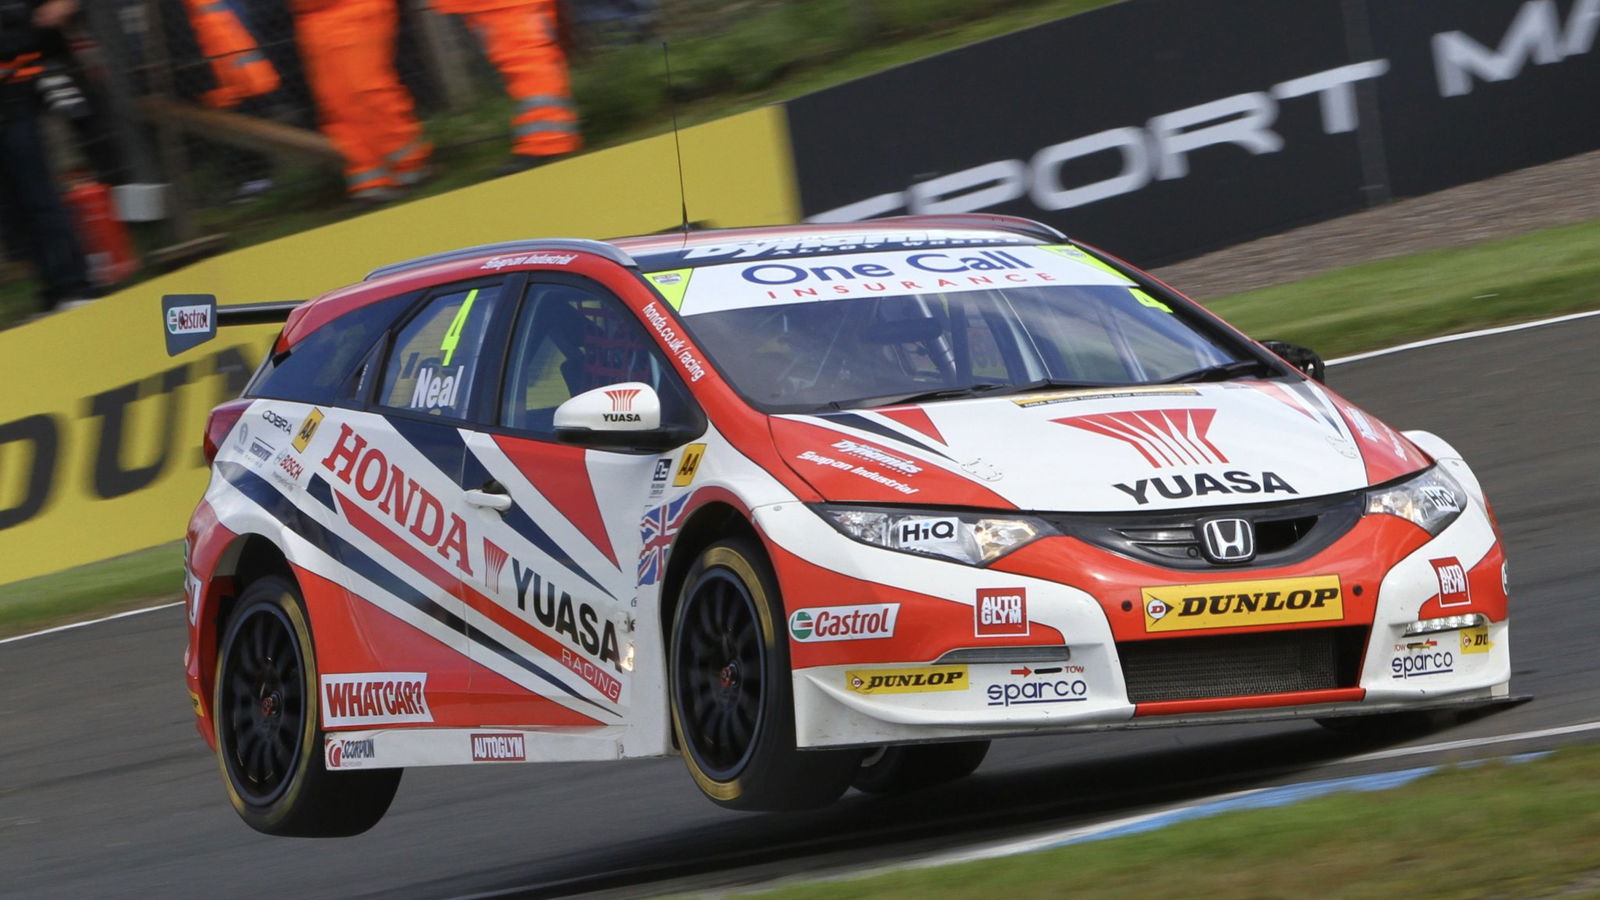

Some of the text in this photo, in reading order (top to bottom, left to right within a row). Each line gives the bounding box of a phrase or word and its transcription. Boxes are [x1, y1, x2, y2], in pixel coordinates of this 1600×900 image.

[742, 250, 1035, 285] One Call
[767, 273, 1056, 299] INSURANCE
[178, 308, 208, 330] Castrol
[440, 289, 479, 366] 4
[410, 365, 464, 408] Neal
[262, 410, 293, 434] COBRA
[300, 418, 317, 442] AA
[602, 413, 642, 422] YUASA
[280, 454, 304, 480] BOSCH
[679, 453, 699, 475] AA
[850, 466, 919, 495] Industrial
[1112, 470, 1299, 506] YUASA
[321, 422, 474, 577] HONDA
[902, 521, 955, 543] HiQ
[1438, 564, 1464, 580] AUTO
[1442, 577, 1466, 594] GLYM
[512, 557, 623, 674] YUASA
[982, 595, 1021, 610] AUTO
[1178, 588, 1339, 617] DUNLOP
[814, 608, 889, 637] Castrol
[981, 608, 1022, 625] GLYM
[561, 648, 620, 699] RACING
[1392, 651, 1453, 679] sparco
[866, 671, 963, 690] DUNLOP
[987, 680, 1087, 707] sparco
[474, 736, 524, 759] AUTOGLYM
